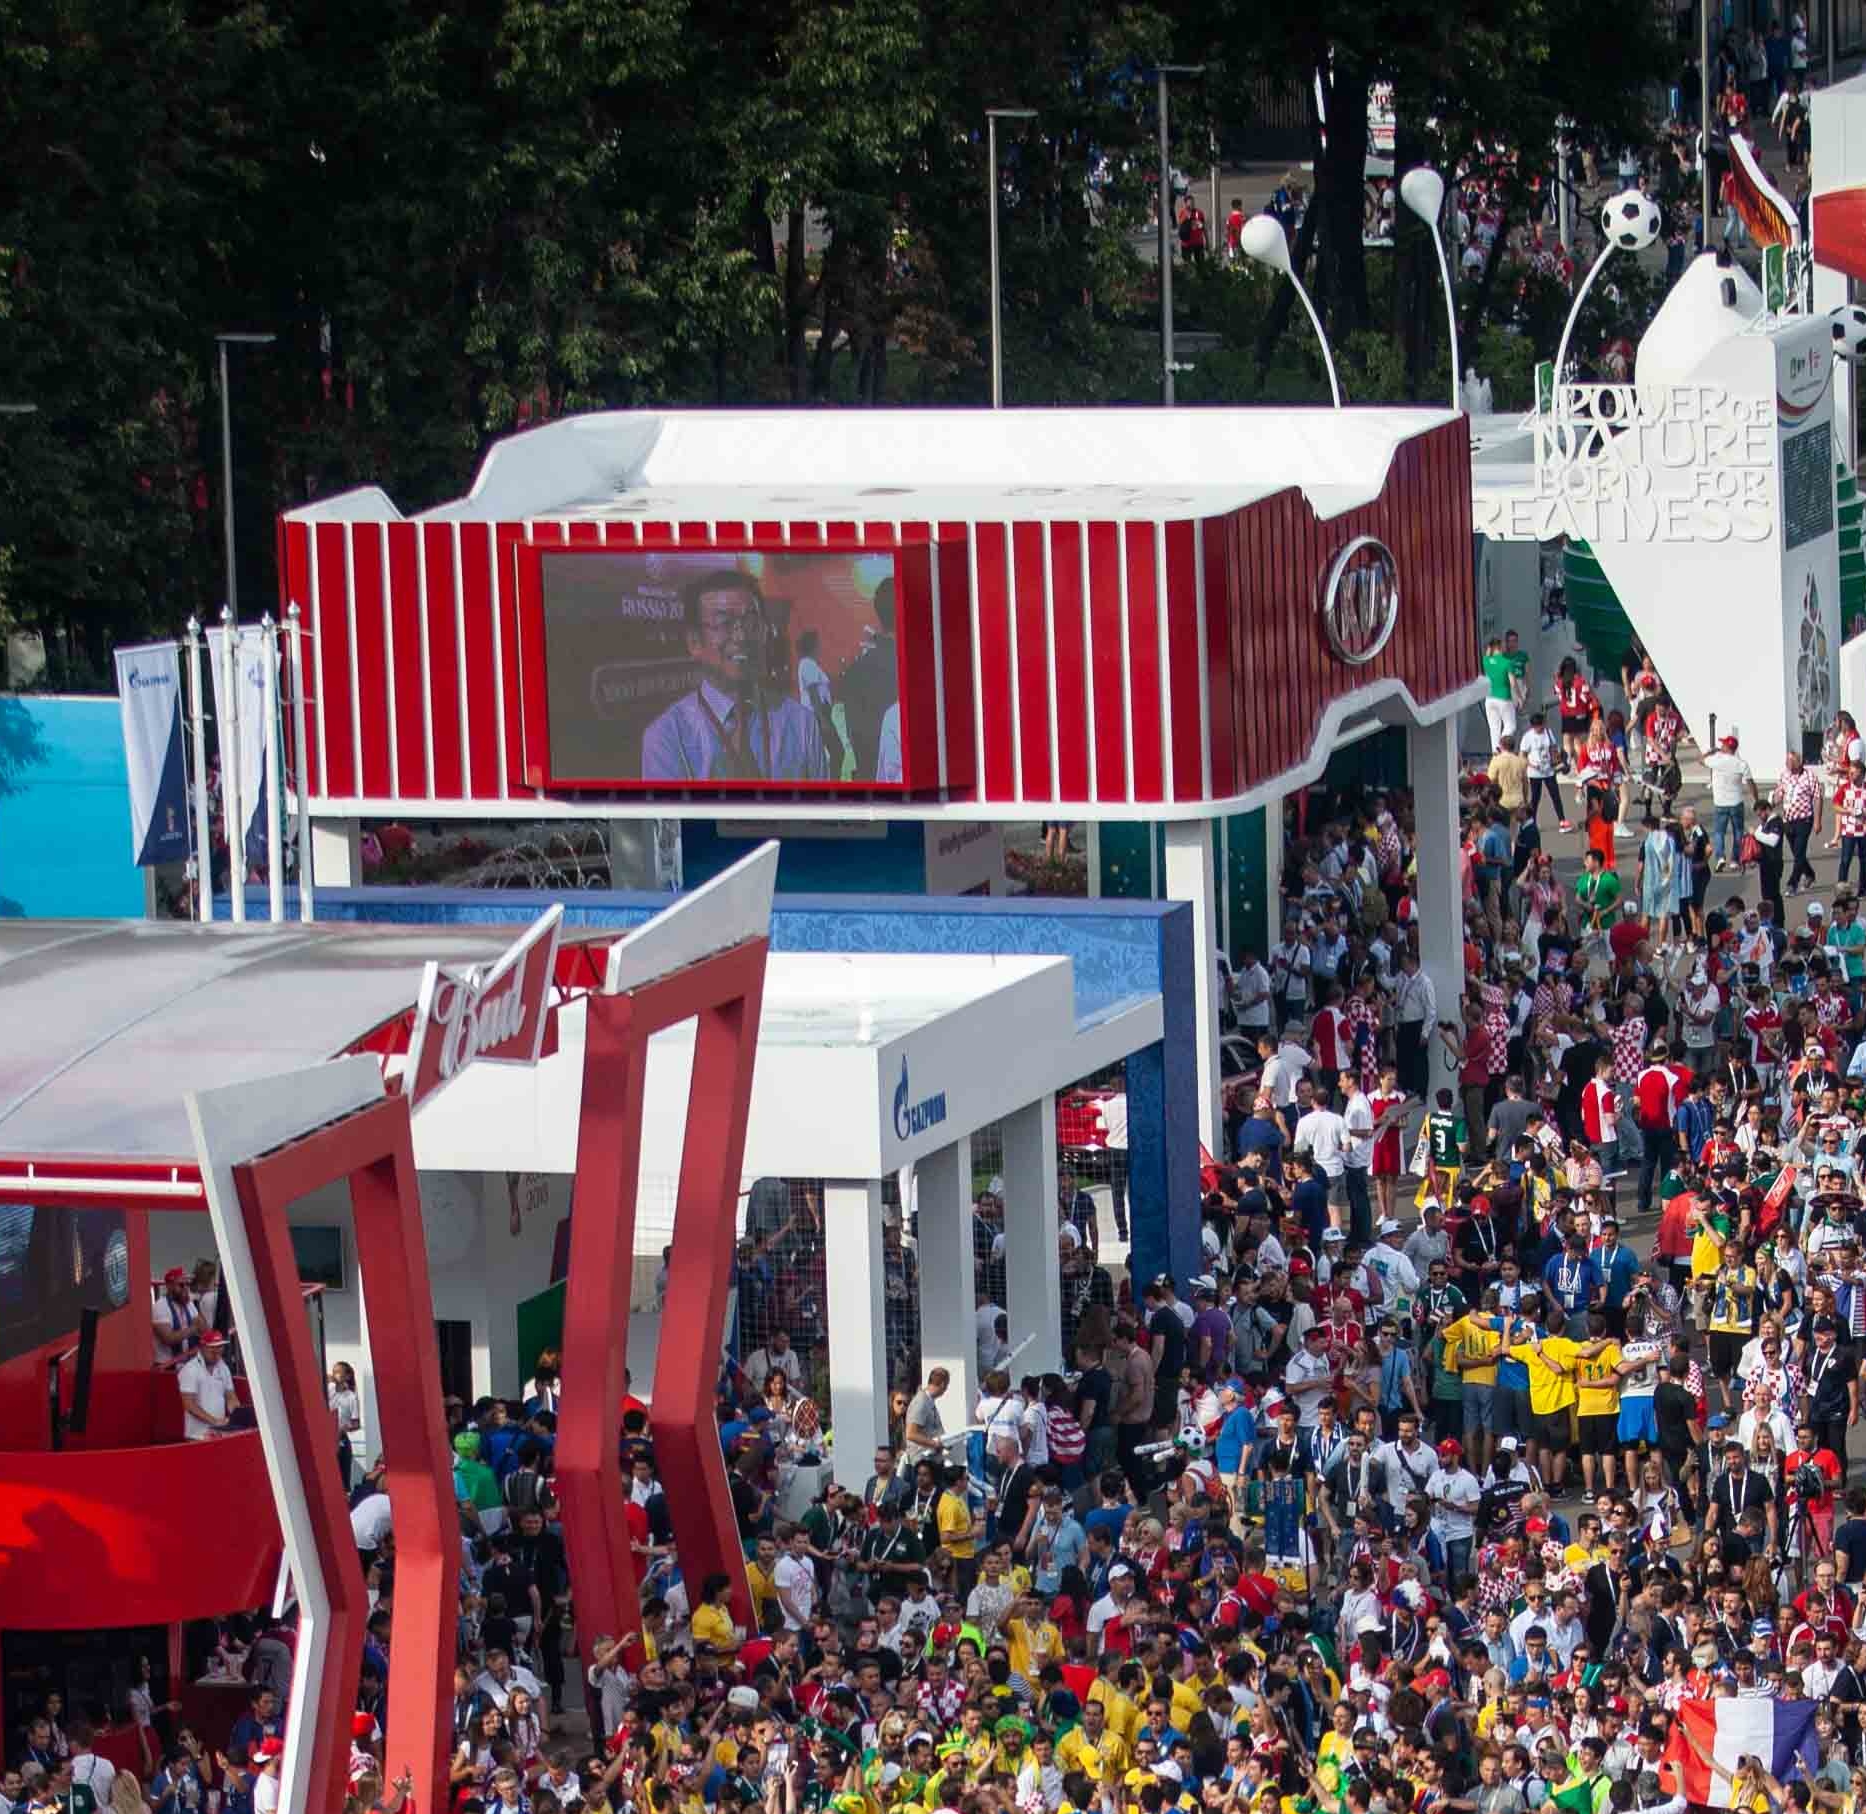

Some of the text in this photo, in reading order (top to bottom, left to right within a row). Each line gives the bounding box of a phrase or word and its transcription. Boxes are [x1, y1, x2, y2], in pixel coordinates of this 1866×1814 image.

[1562, 384, 1770, 423] POWER OF
[1534, 418, 1774, 467] NATURE
[1536, 466, 1768, 500] BORN FOR
[1472, 498, 1775, 543] REATNESS
[1435, 1129, 1446, 1153] 3
